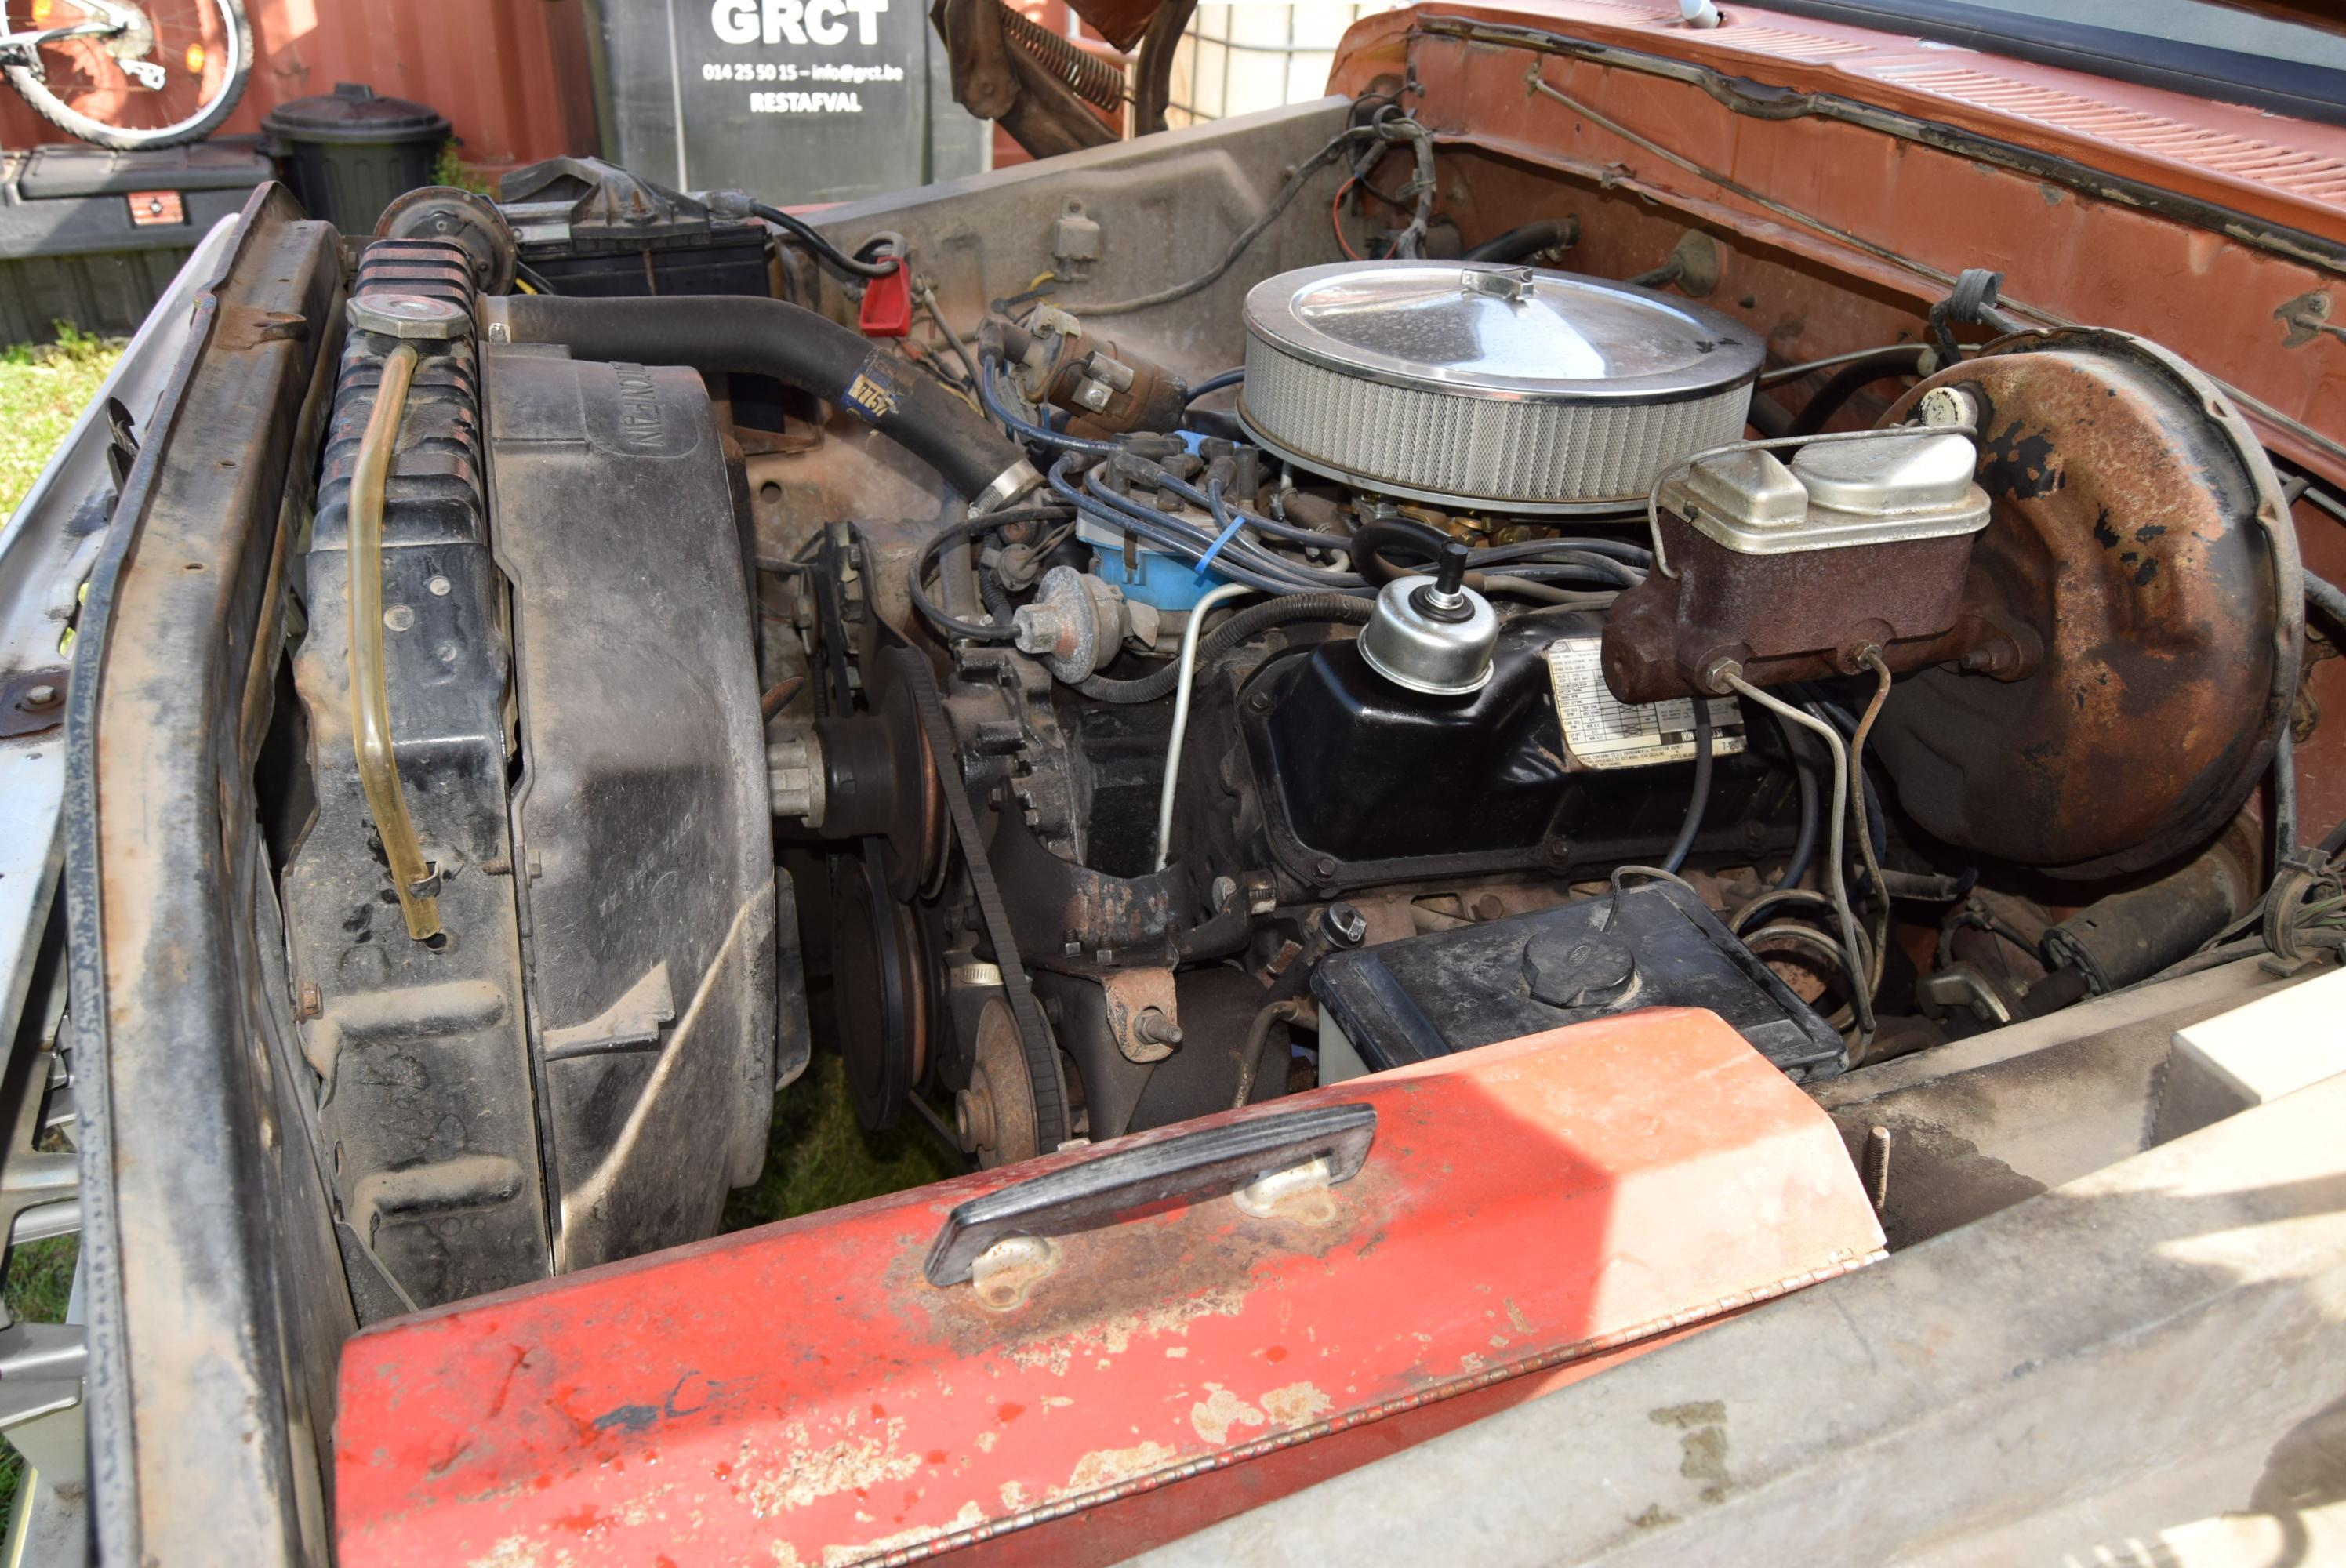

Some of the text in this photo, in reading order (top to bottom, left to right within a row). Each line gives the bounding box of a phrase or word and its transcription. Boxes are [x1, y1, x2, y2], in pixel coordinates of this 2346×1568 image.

[711, 0, 888, 45] GRCT
[703, 64, 732, 80] 014
[734, 64, 755, 80] 25
[756, 64, 777, 80] 50
[778, 64, 798, 80] 15
[812, 64, 904, 83] info@grct.be
[750, 92, 862, 112] RESTAFVAL
[856, 383, 891, 416] 7757
[623, 402, 665, 446] FAN
